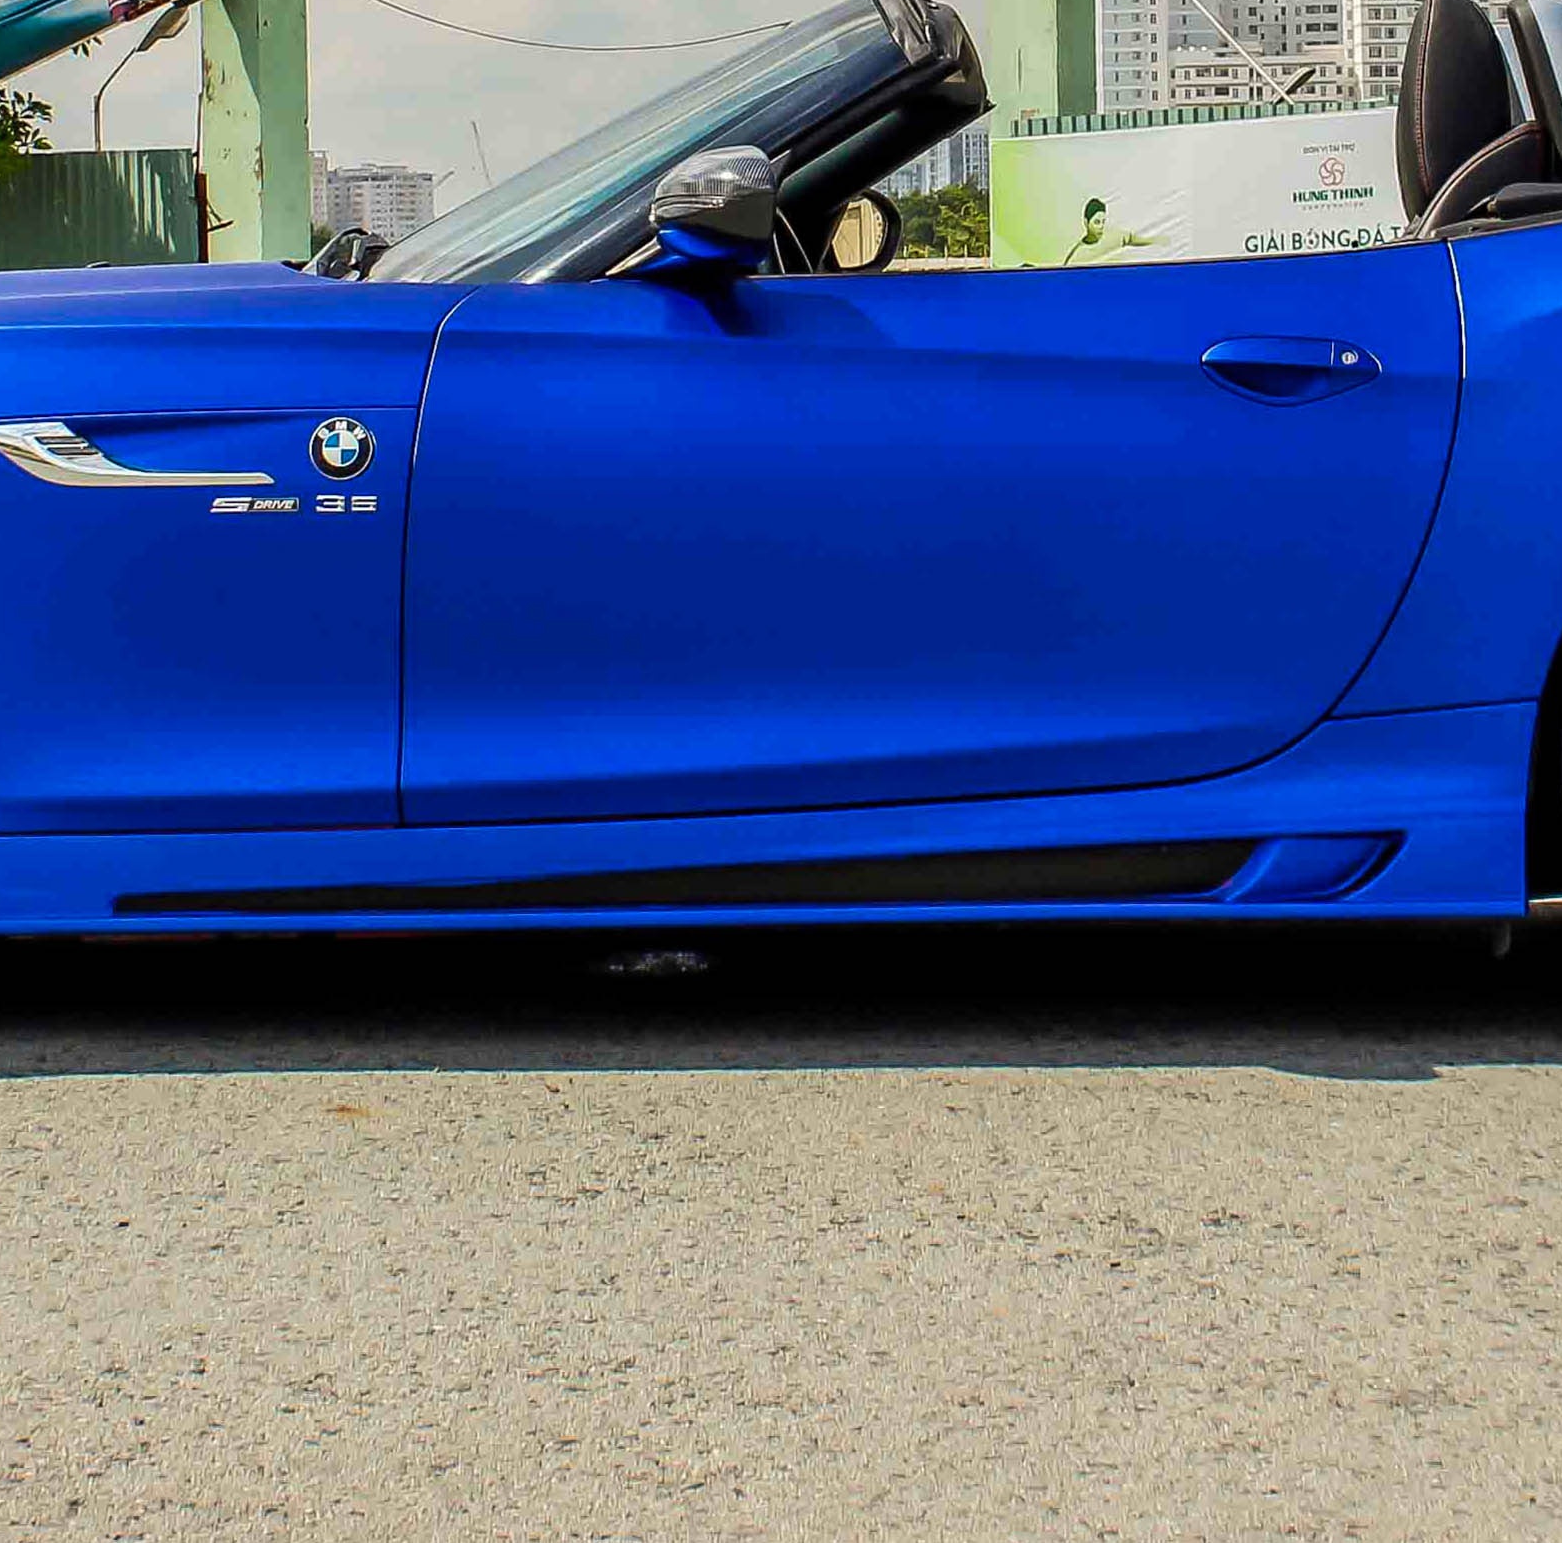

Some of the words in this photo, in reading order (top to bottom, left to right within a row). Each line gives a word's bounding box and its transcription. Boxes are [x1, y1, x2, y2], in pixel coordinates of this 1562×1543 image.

[1244, 228, 1286, 253] GIẢI
[1291, 227, 1352, 252] BÓNG
[1357, 223, 1386, 247] ĐÁ
[315, 494, 378, 513] 35
